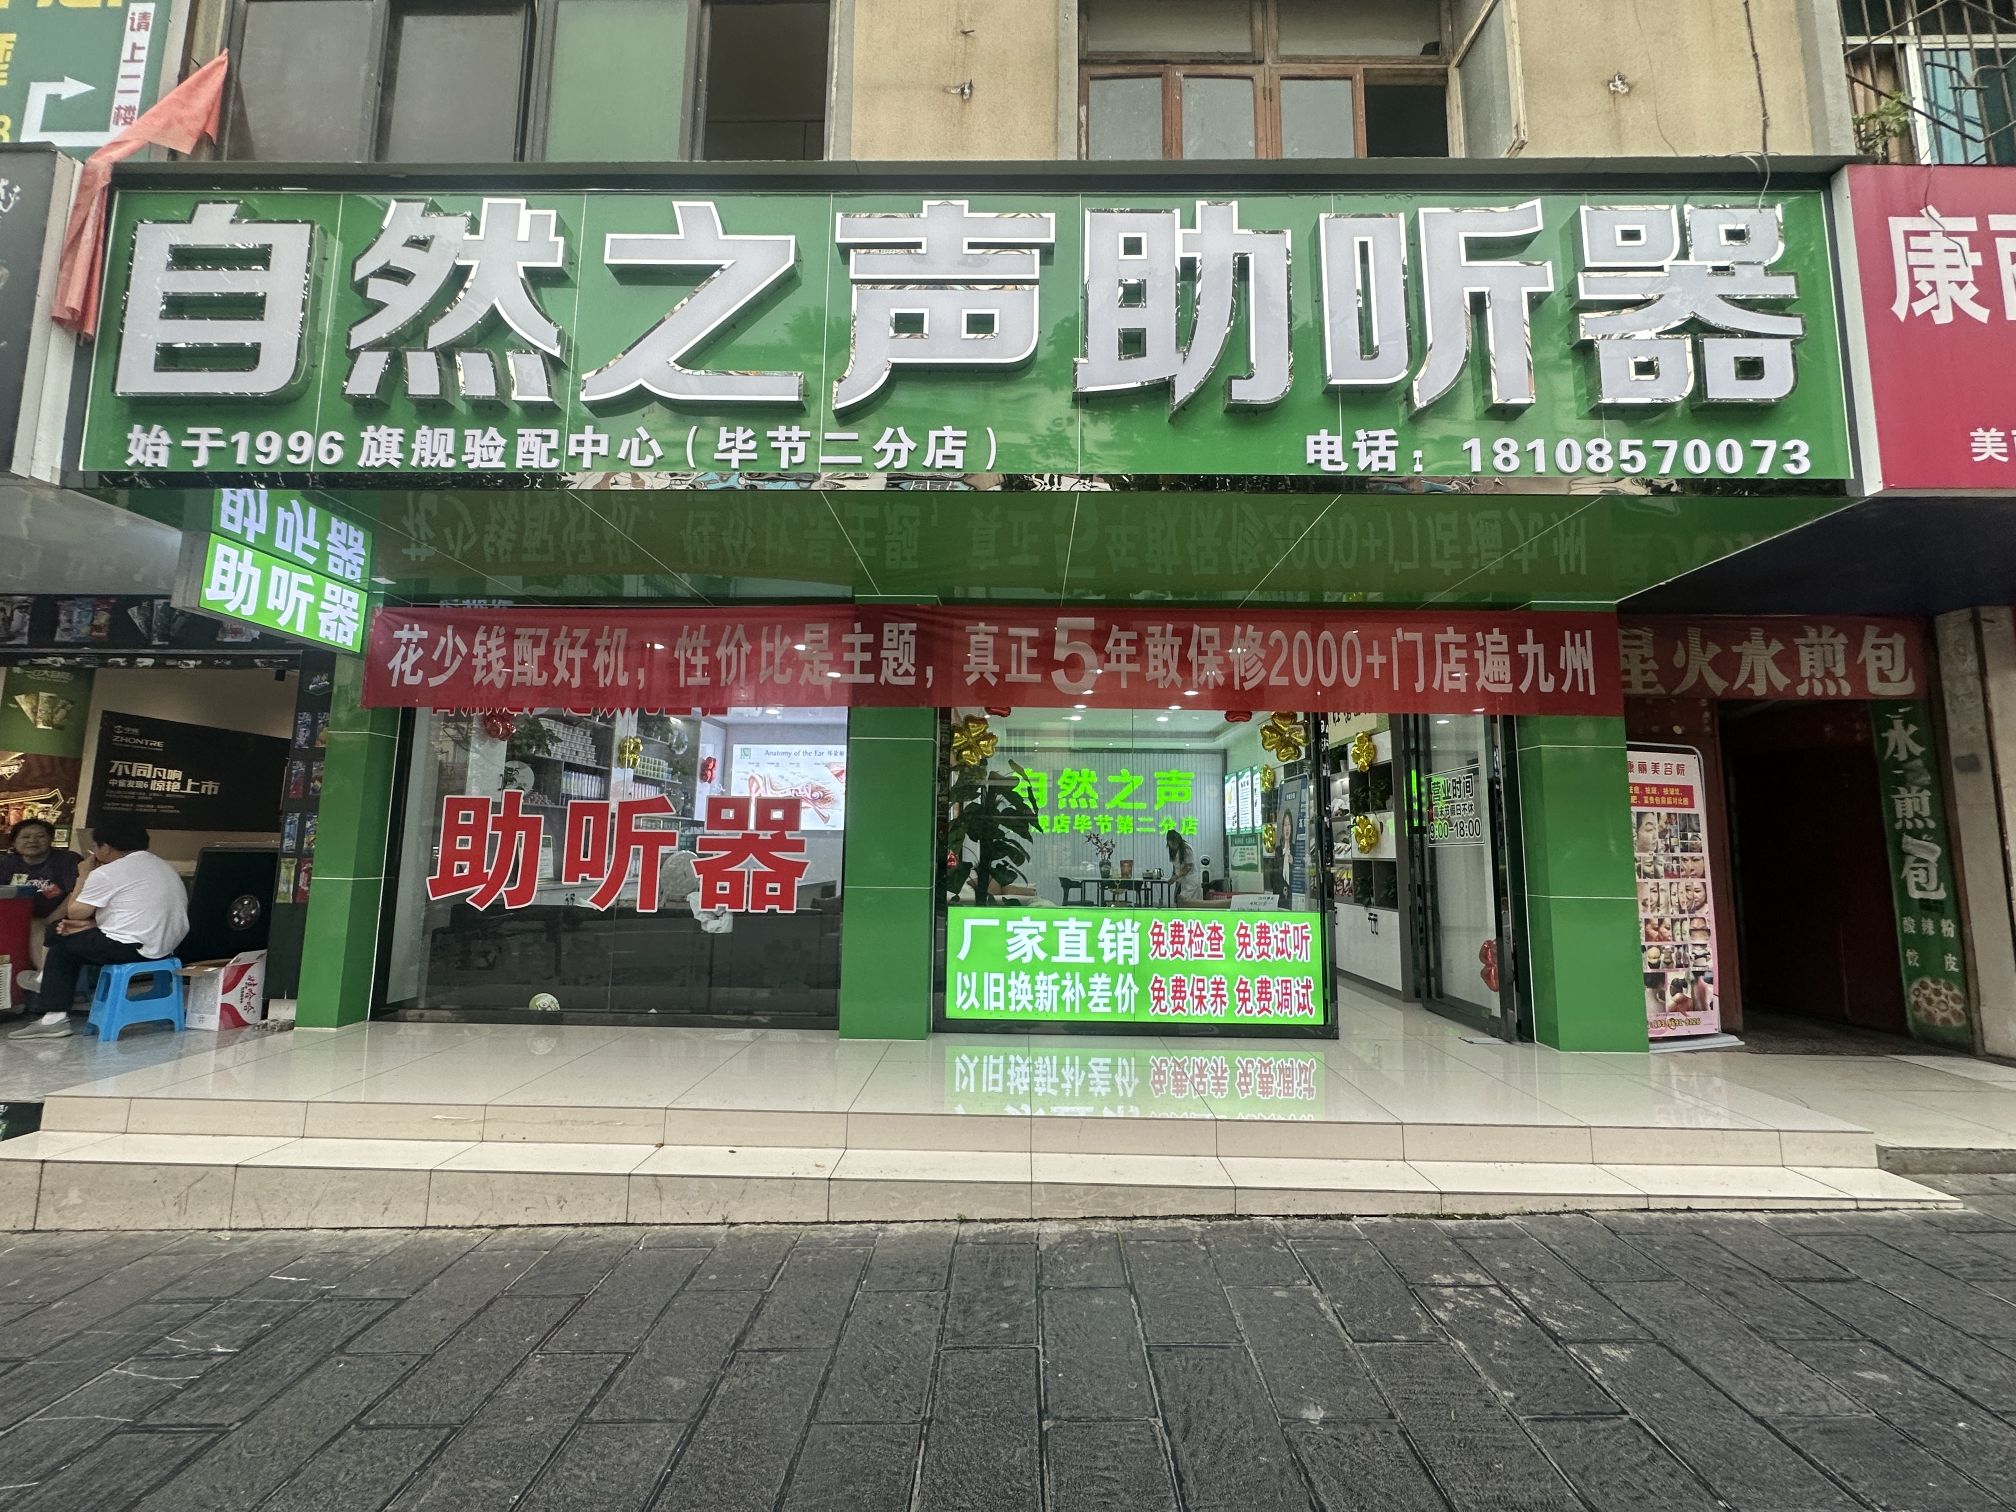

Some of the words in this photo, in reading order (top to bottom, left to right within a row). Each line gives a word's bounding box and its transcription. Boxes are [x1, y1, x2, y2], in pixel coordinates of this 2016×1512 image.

[112, 11, 152, 126] 请上二楼
[114, 196, 1804, 416] 自然之声助听器
[1461, 437, 1811, 474] 18108570073
[1969, 428, 2016, 463] 美
[205, 543, 359, 647] 助听器
[1620, 624, 1916, 697] 星火水煎包
[109, 760, 183, 780] 不同凡响
[764, 749, 792, 758] Anatomy
[794, 748, 802, 756] of
[802, 748, 812, 757] the
[814, 749, 825, 757] Ear
[149, 778, 220, 795] 惊艳上市
[1012, 768, 1196, 810] 自然之声
[1431, 773, 1475, 803] 营业时间
[1881, 706, 1948, 900] 水煎包
[1429, 817, 1482, 840] 9:00-18:00
[427, 790, 811, 914] 助听器
[957, 916, 1141, 966] 厂家直销
[1148, 919, 1225, 961] 免费检查
[1234, 920, 1312, 962] 免费试听
[1902, 916, 1956, 938] 酸辣粉
[956, 971, 1140, 1014] 以旧换新补差价
[1148, 974, 1229, 1016] 免费保养
[1233, 975, 1316, 1018] 免费调试
